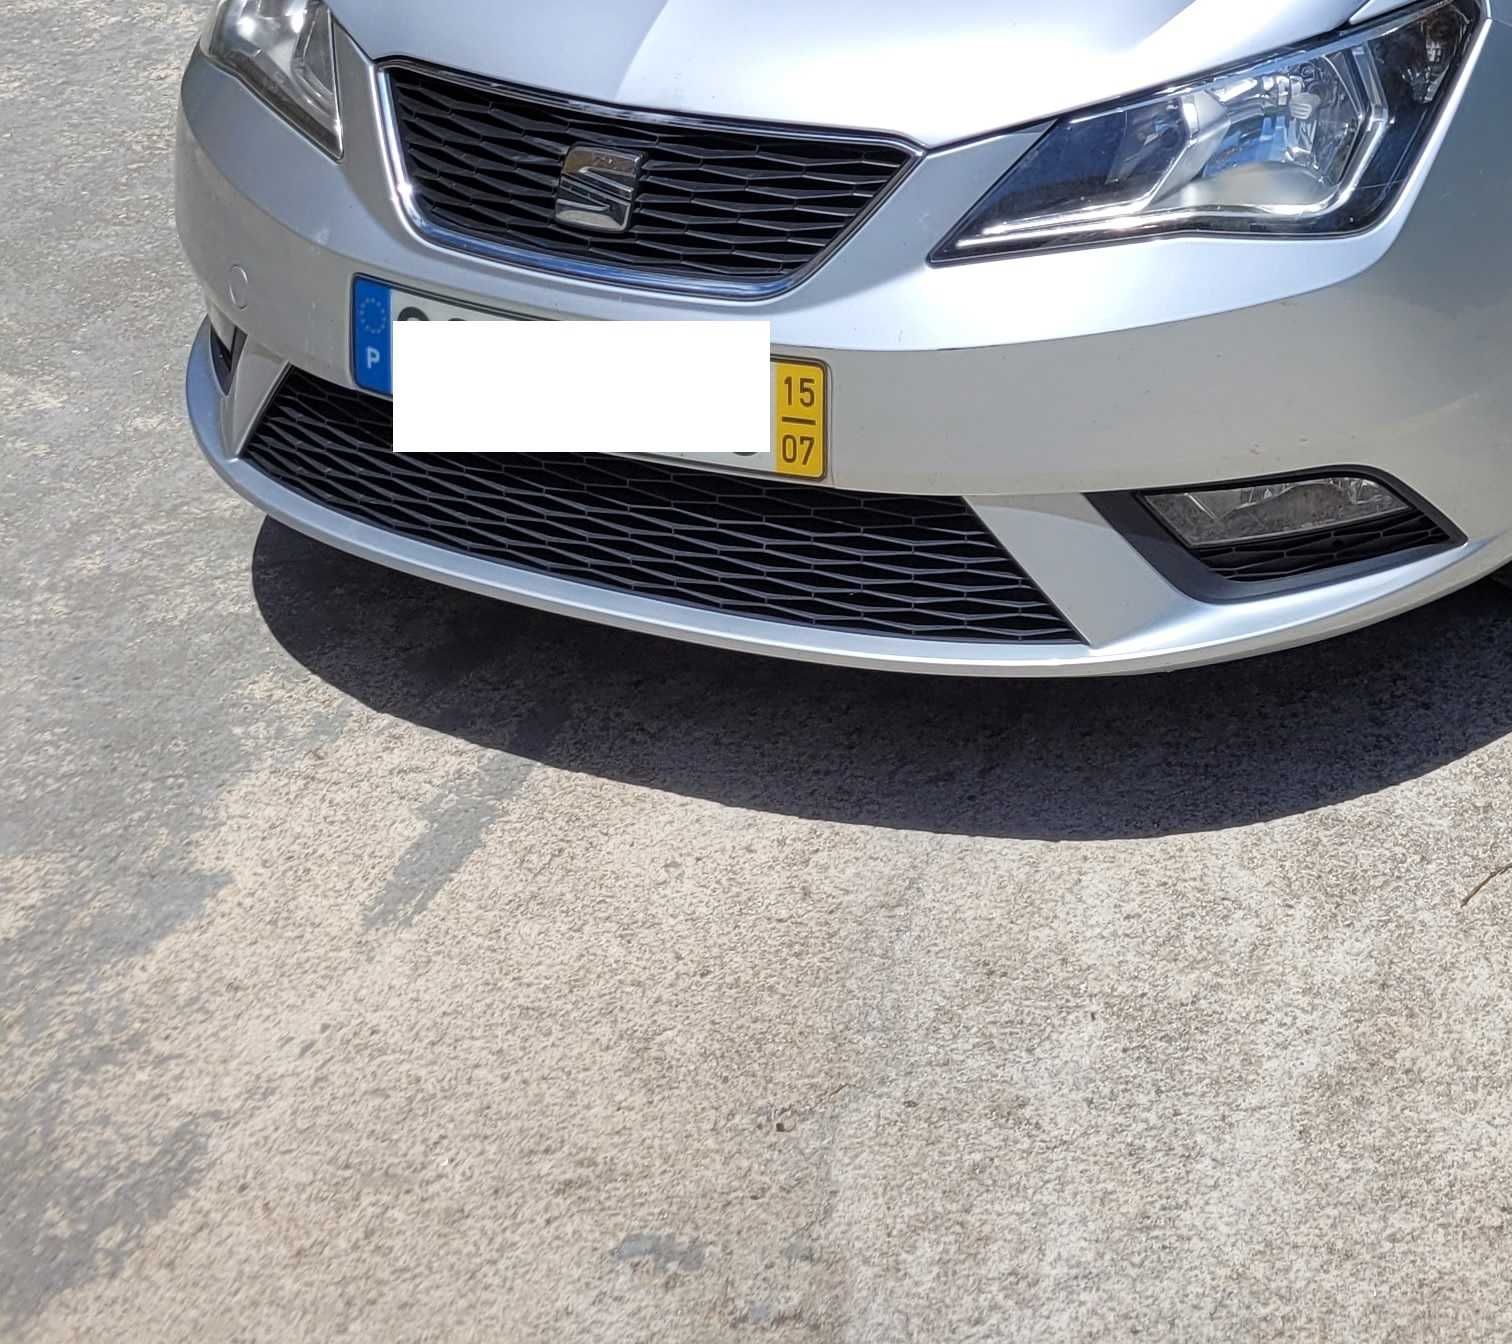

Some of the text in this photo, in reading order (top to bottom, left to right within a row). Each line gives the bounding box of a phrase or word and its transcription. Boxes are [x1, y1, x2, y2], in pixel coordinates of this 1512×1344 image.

[366, 345, 380, 369] P
[783, 375, 815, 408] 15
[782, 433, 815, 466] 07
